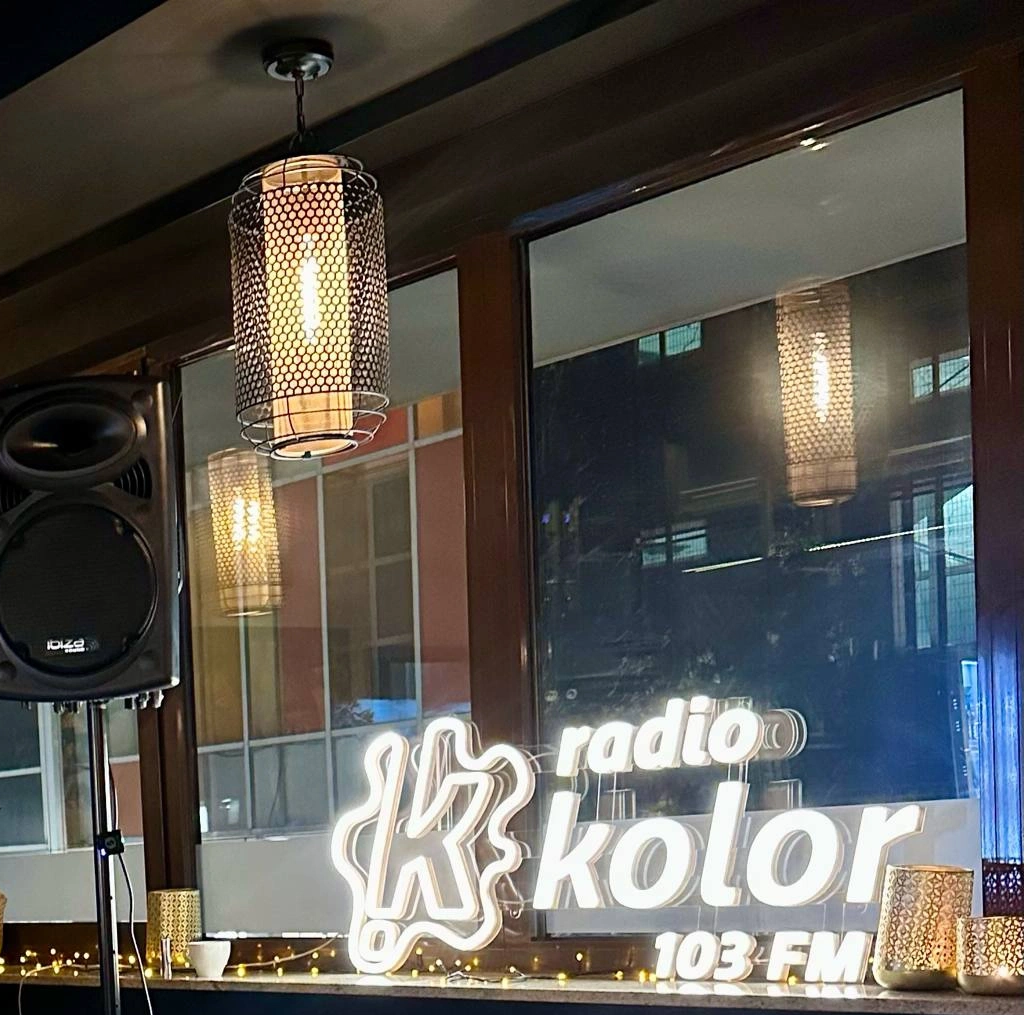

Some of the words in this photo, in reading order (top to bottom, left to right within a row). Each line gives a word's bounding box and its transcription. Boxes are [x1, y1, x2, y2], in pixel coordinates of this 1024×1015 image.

[556, 697, 763, 776] radio
[533, 781, 926, 909] kolor
[654, 931, 755, 982] 103
[766, 932, 874, 983] FM
